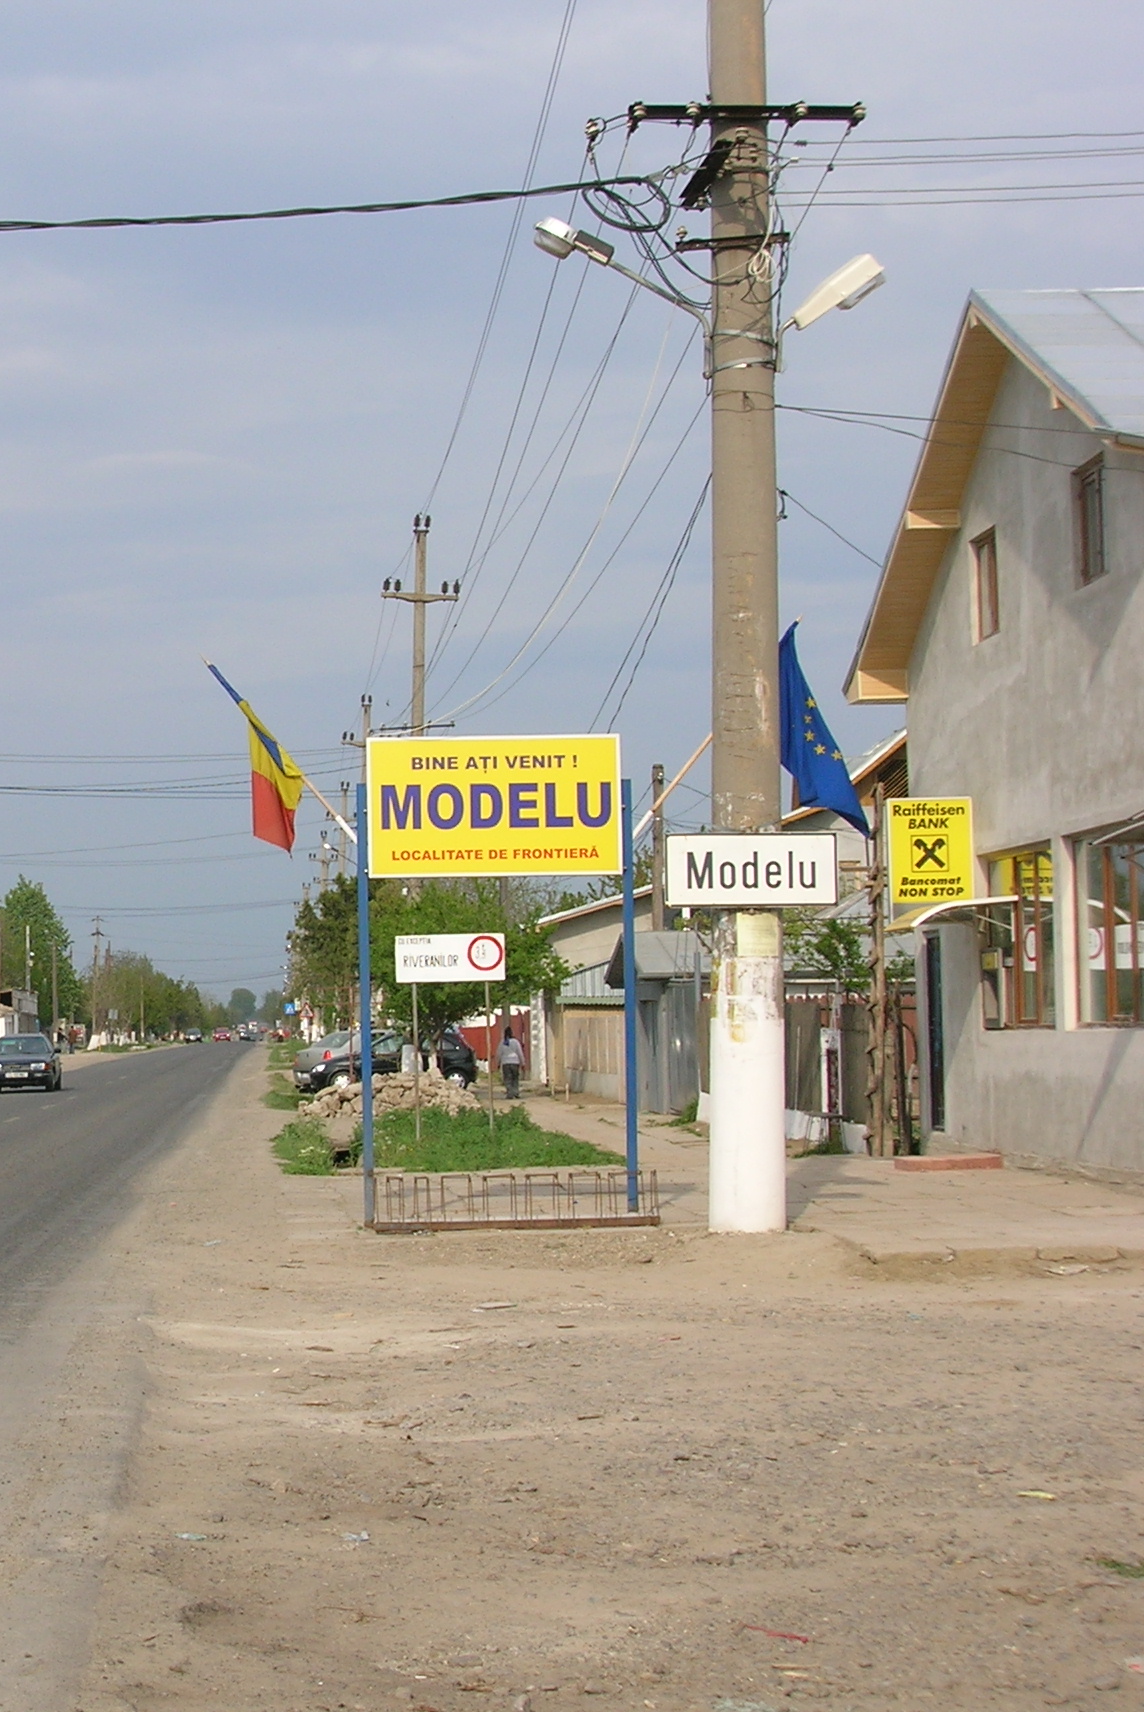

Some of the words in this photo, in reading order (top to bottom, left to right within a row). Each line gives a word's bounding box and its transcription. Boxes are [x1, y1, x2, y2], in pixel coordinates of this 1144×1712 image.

[411, 756, 458, 770] BINE
[505, 755, 566, 769] VENIT
[381, 781, 612, 830] MODELU
[892, 803, 965, 817] Raiffeisen
[908, 818, 949, 829] BANK
[391, 849, 483, 861] LOCALITATE
[488, 849, 508, 860] DE
[686, 851, 816, 889] Modelu
[901, 876, 961, 886] Bancomat
[899, 887, 930, 898] NON
[932, 886, 965, 897] STOP
